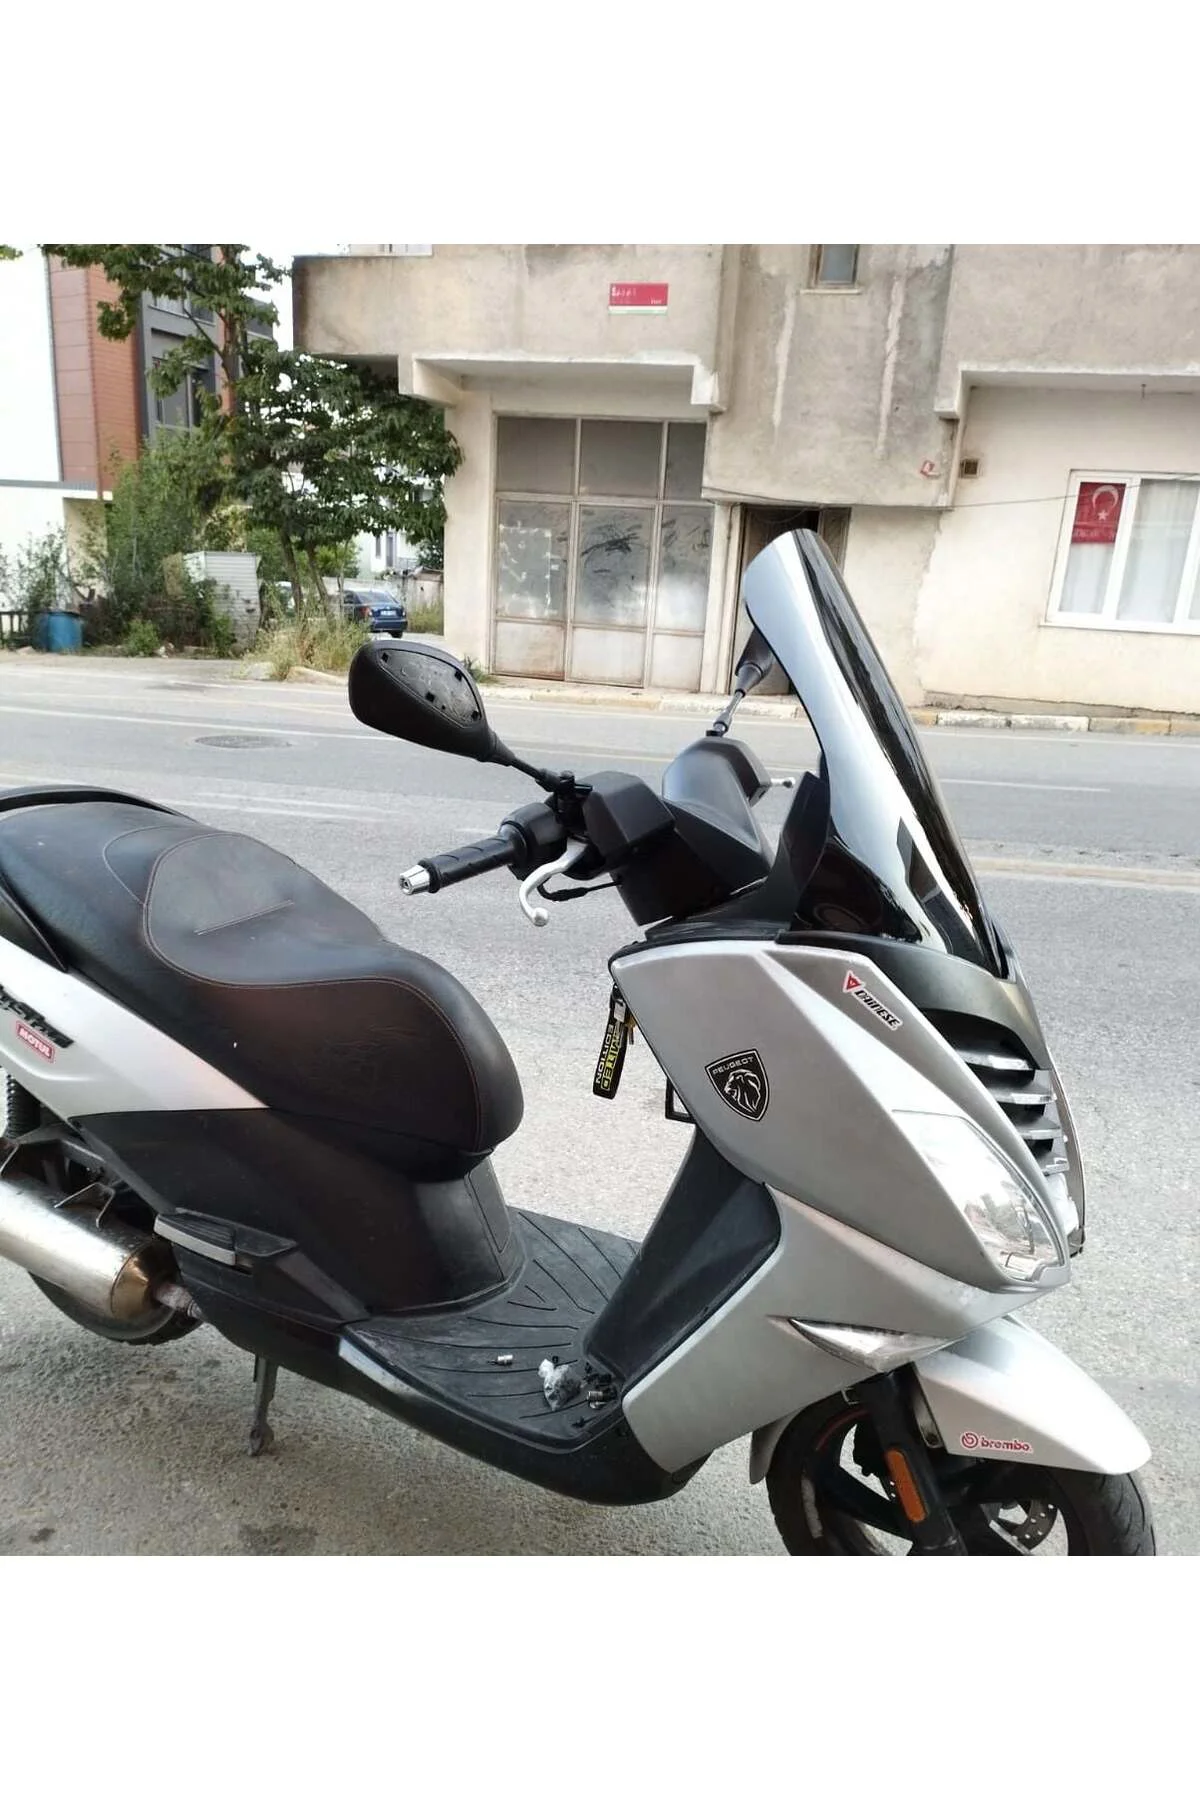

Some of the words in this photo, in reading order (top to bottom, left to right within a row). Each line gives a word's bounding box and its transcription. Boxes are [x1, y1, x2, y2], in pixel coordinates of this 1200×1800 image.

[18, 1026, 52, 1059] MOTUL
[595, 1023, 615, 1084] EDITION
[712, 1056, 754, 1075] PEUGEOT
[980, 1436, 1030, 1452] brembo
